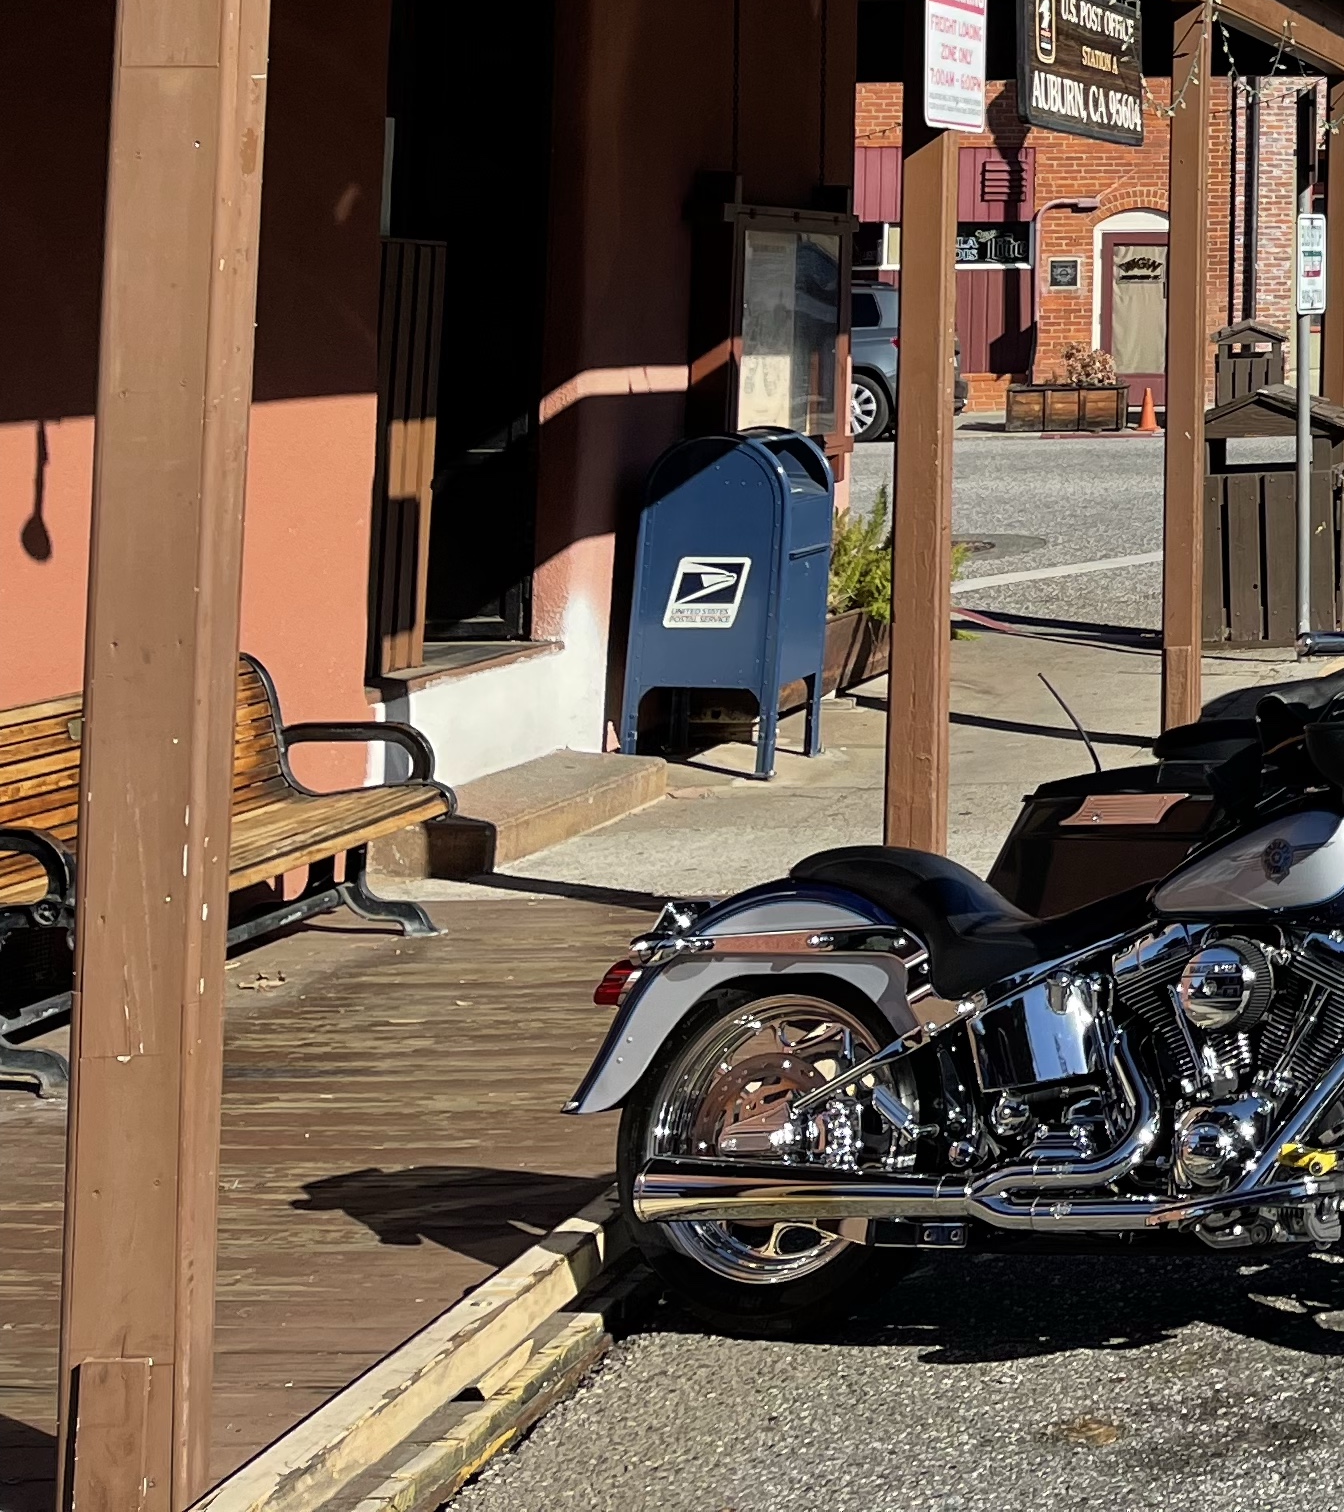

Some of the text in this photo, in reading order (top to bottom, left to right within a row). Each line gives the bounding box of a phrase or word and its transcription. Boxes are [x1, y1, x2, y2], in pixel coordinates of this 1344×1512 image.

[930, 14, 982, 42] FREIGHT LOADING
[1079, 1, 1102, 32] POST
[1104, 10, 1135, 43] OFFICE
[941, 43, 973, 65] ZONE ONLY
[1081, 45, 1119, 75] STATION A
[930, 68, 955, 88] 7:00AM
[1032, 70, 1141, 131] AUBURN, CA 95604
[669, 615, 731, 623] POSTAL SERVICE
